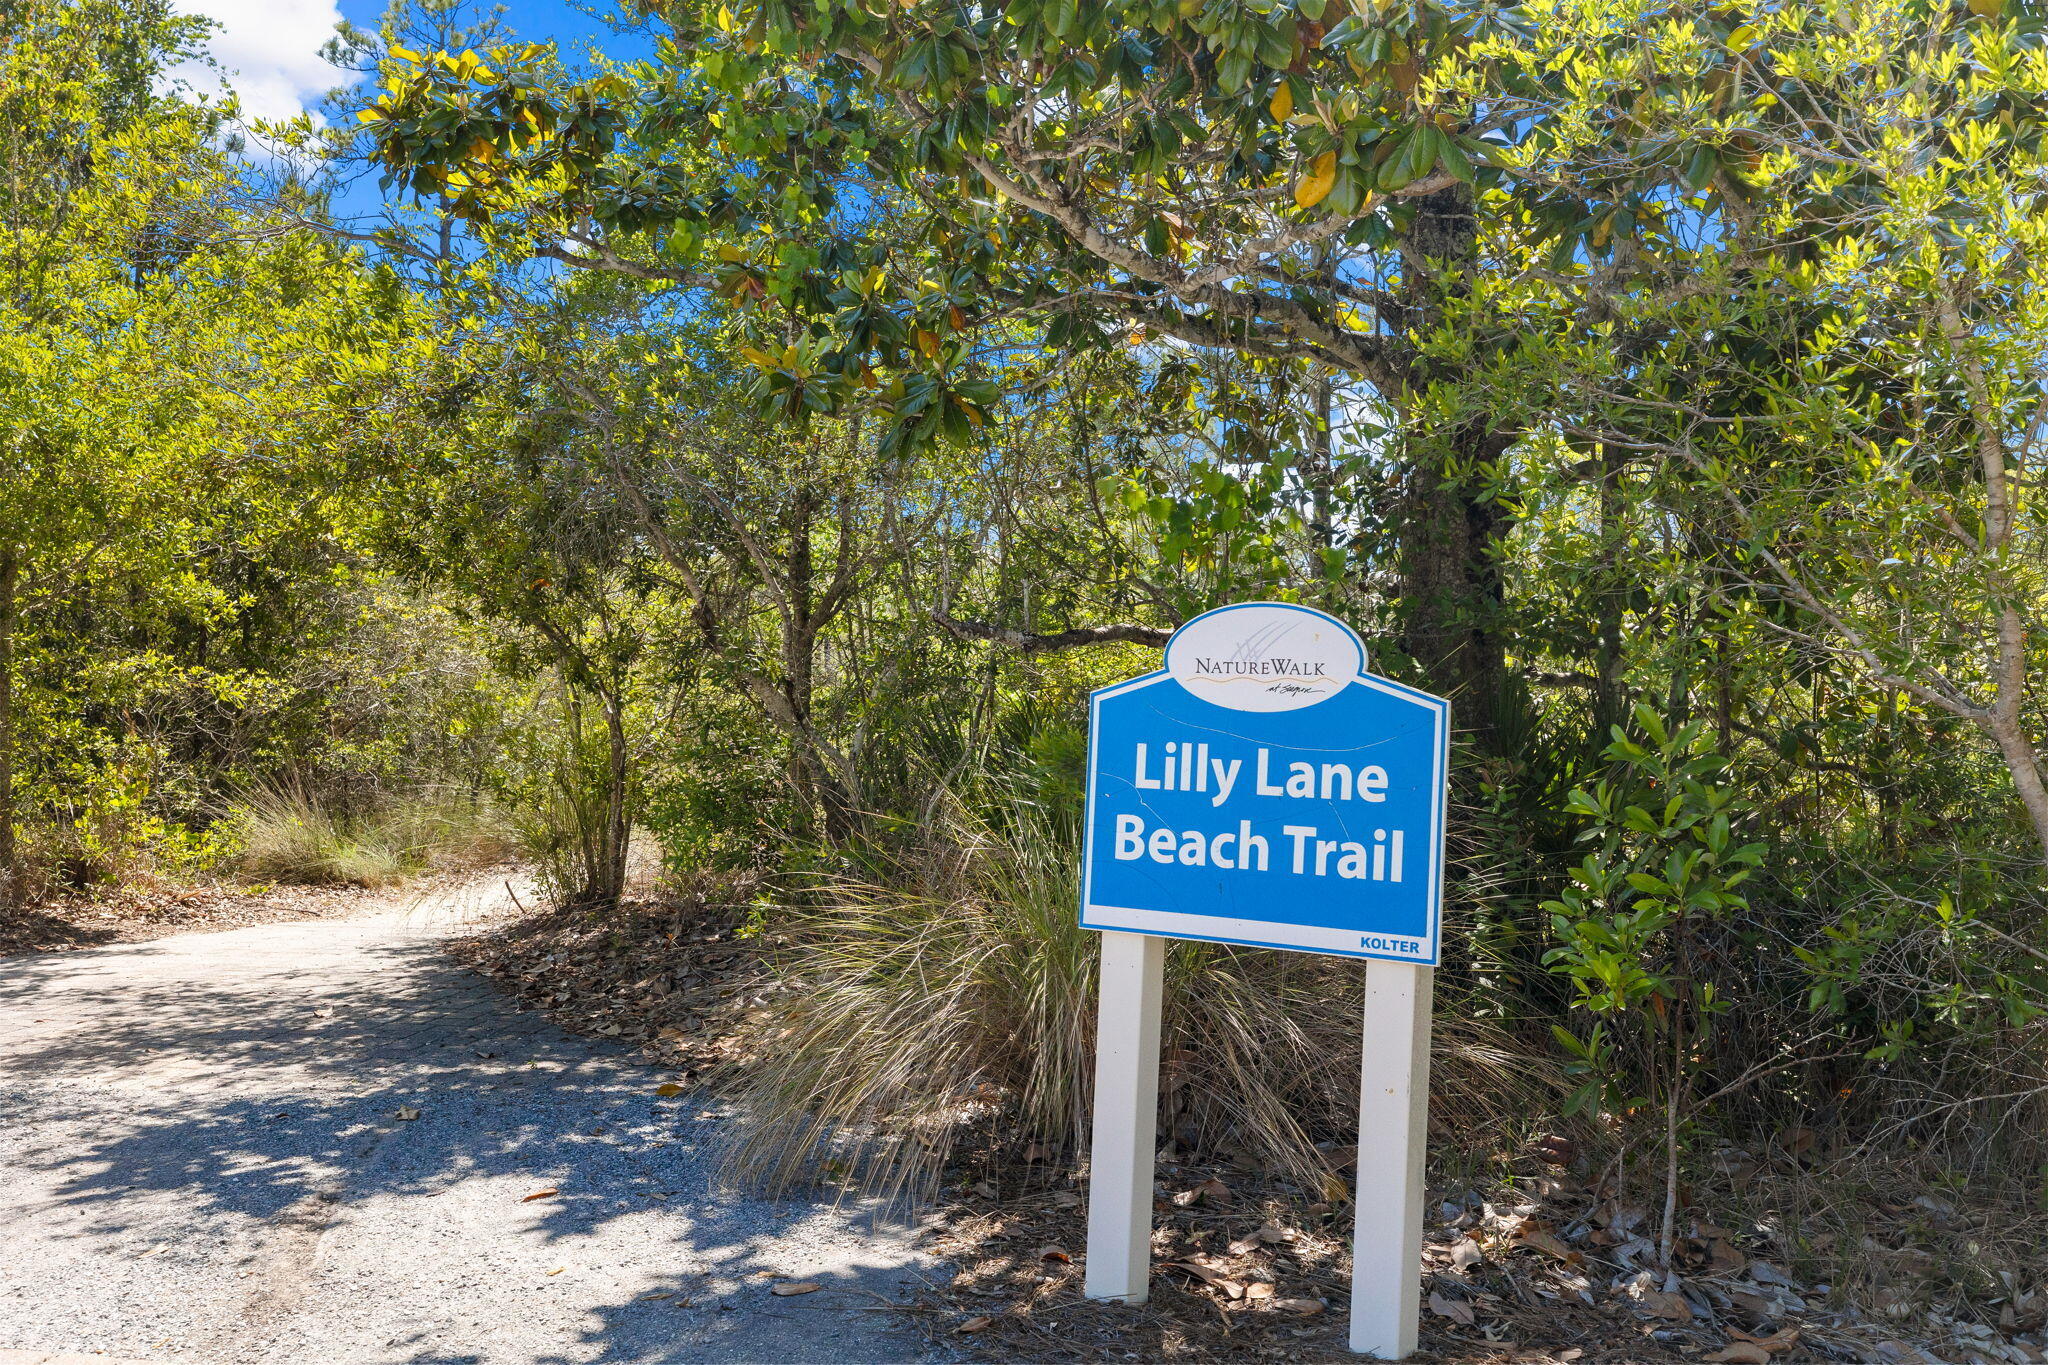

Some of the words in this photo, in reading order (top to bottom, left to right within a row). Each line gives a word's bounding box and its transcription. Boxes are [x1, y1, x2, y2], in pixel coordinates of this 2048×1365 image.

[1134, 741, 1242, 808] Lilly
[1256, 747, 1389, 803] Lane
[1114, 813, 1269, 872] Beach
[1282, 824, 1404, 883] Trail
[1360, 936, 1420, 954] KOLTER
